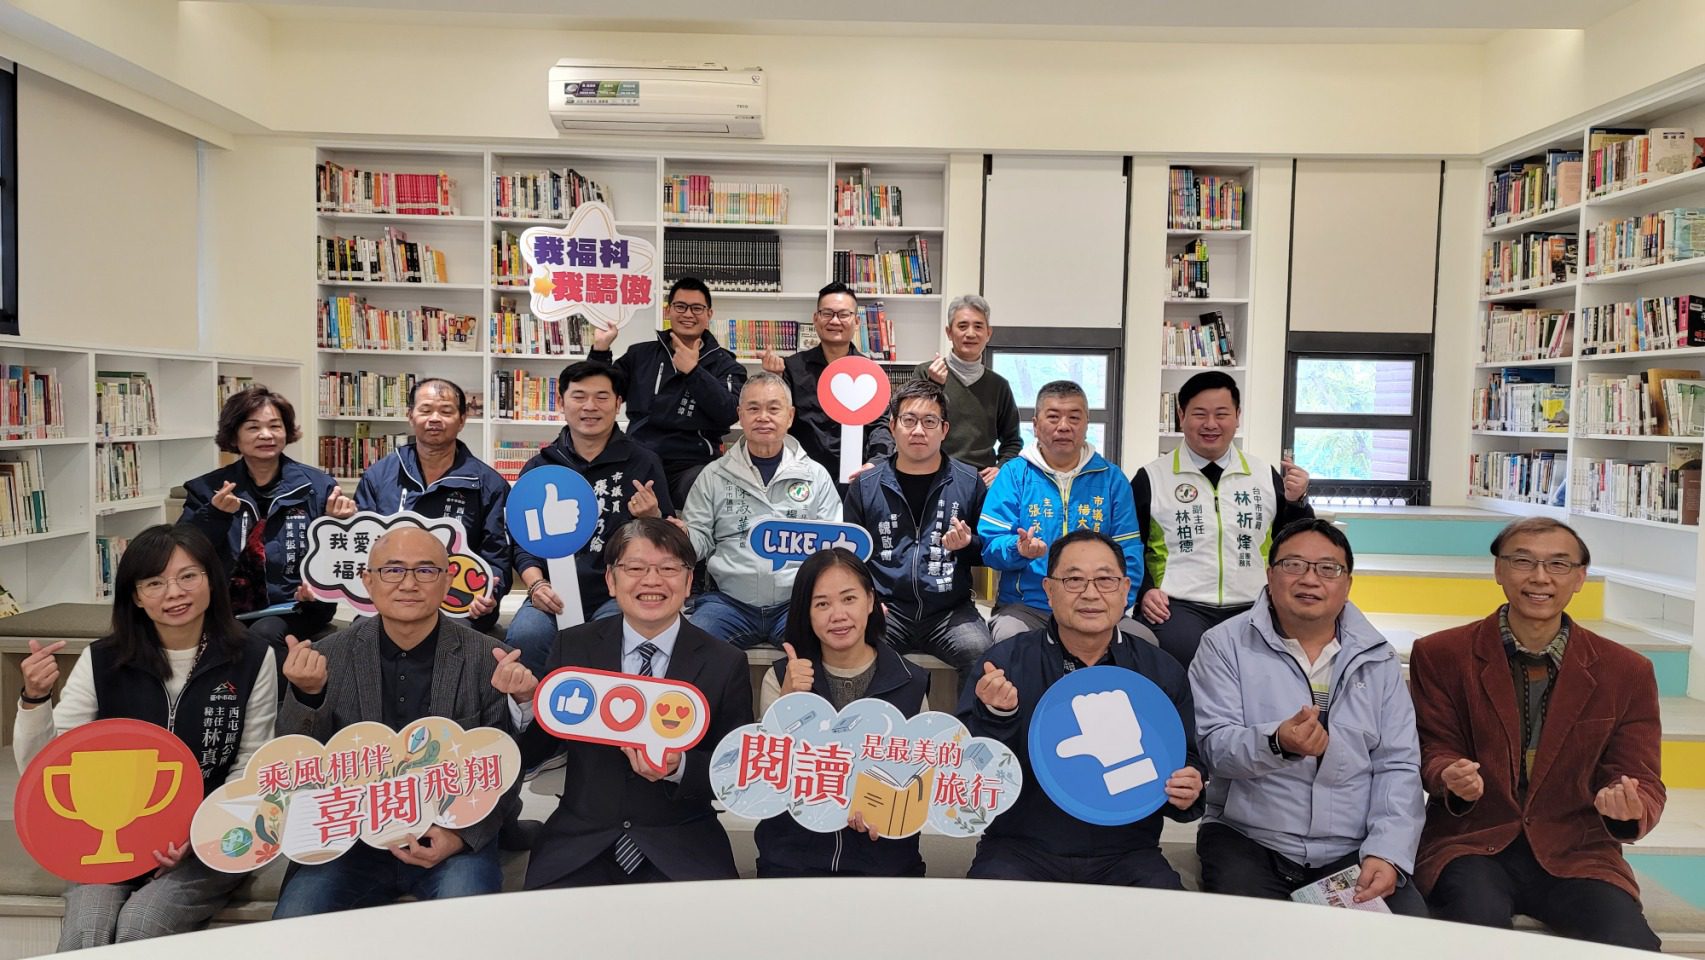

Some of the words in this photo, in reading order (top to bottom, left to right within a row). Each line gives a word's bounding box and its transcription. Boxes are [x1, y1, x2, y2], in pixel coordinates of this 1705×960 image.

[534, 236, 630, 269] 我福科
[551, 271, 652, 305] 我驕傲
[1028, 504, 1043, 541] 張永
[1043, 498, 1054, 518] 主任
[1192, 504, 1205, 535] 副主任
[1234, 491, 1253, 551] 林祈烽
[329, 531, 381, 555] 我愛
[763, 529, 818, 555] LIKE
[1175, 510, 1194, 553] 林柏德
[860, 734, 964, 768] 是最美的
[258, 744, 393, 796] 乘風相伴
[737, 734, 853, 807] 閱讀
[312, 776, 418, 844] 喜閱
[424, 754, 501, 802] 飛翔
[934, 773, 1003, 811] 旅行
